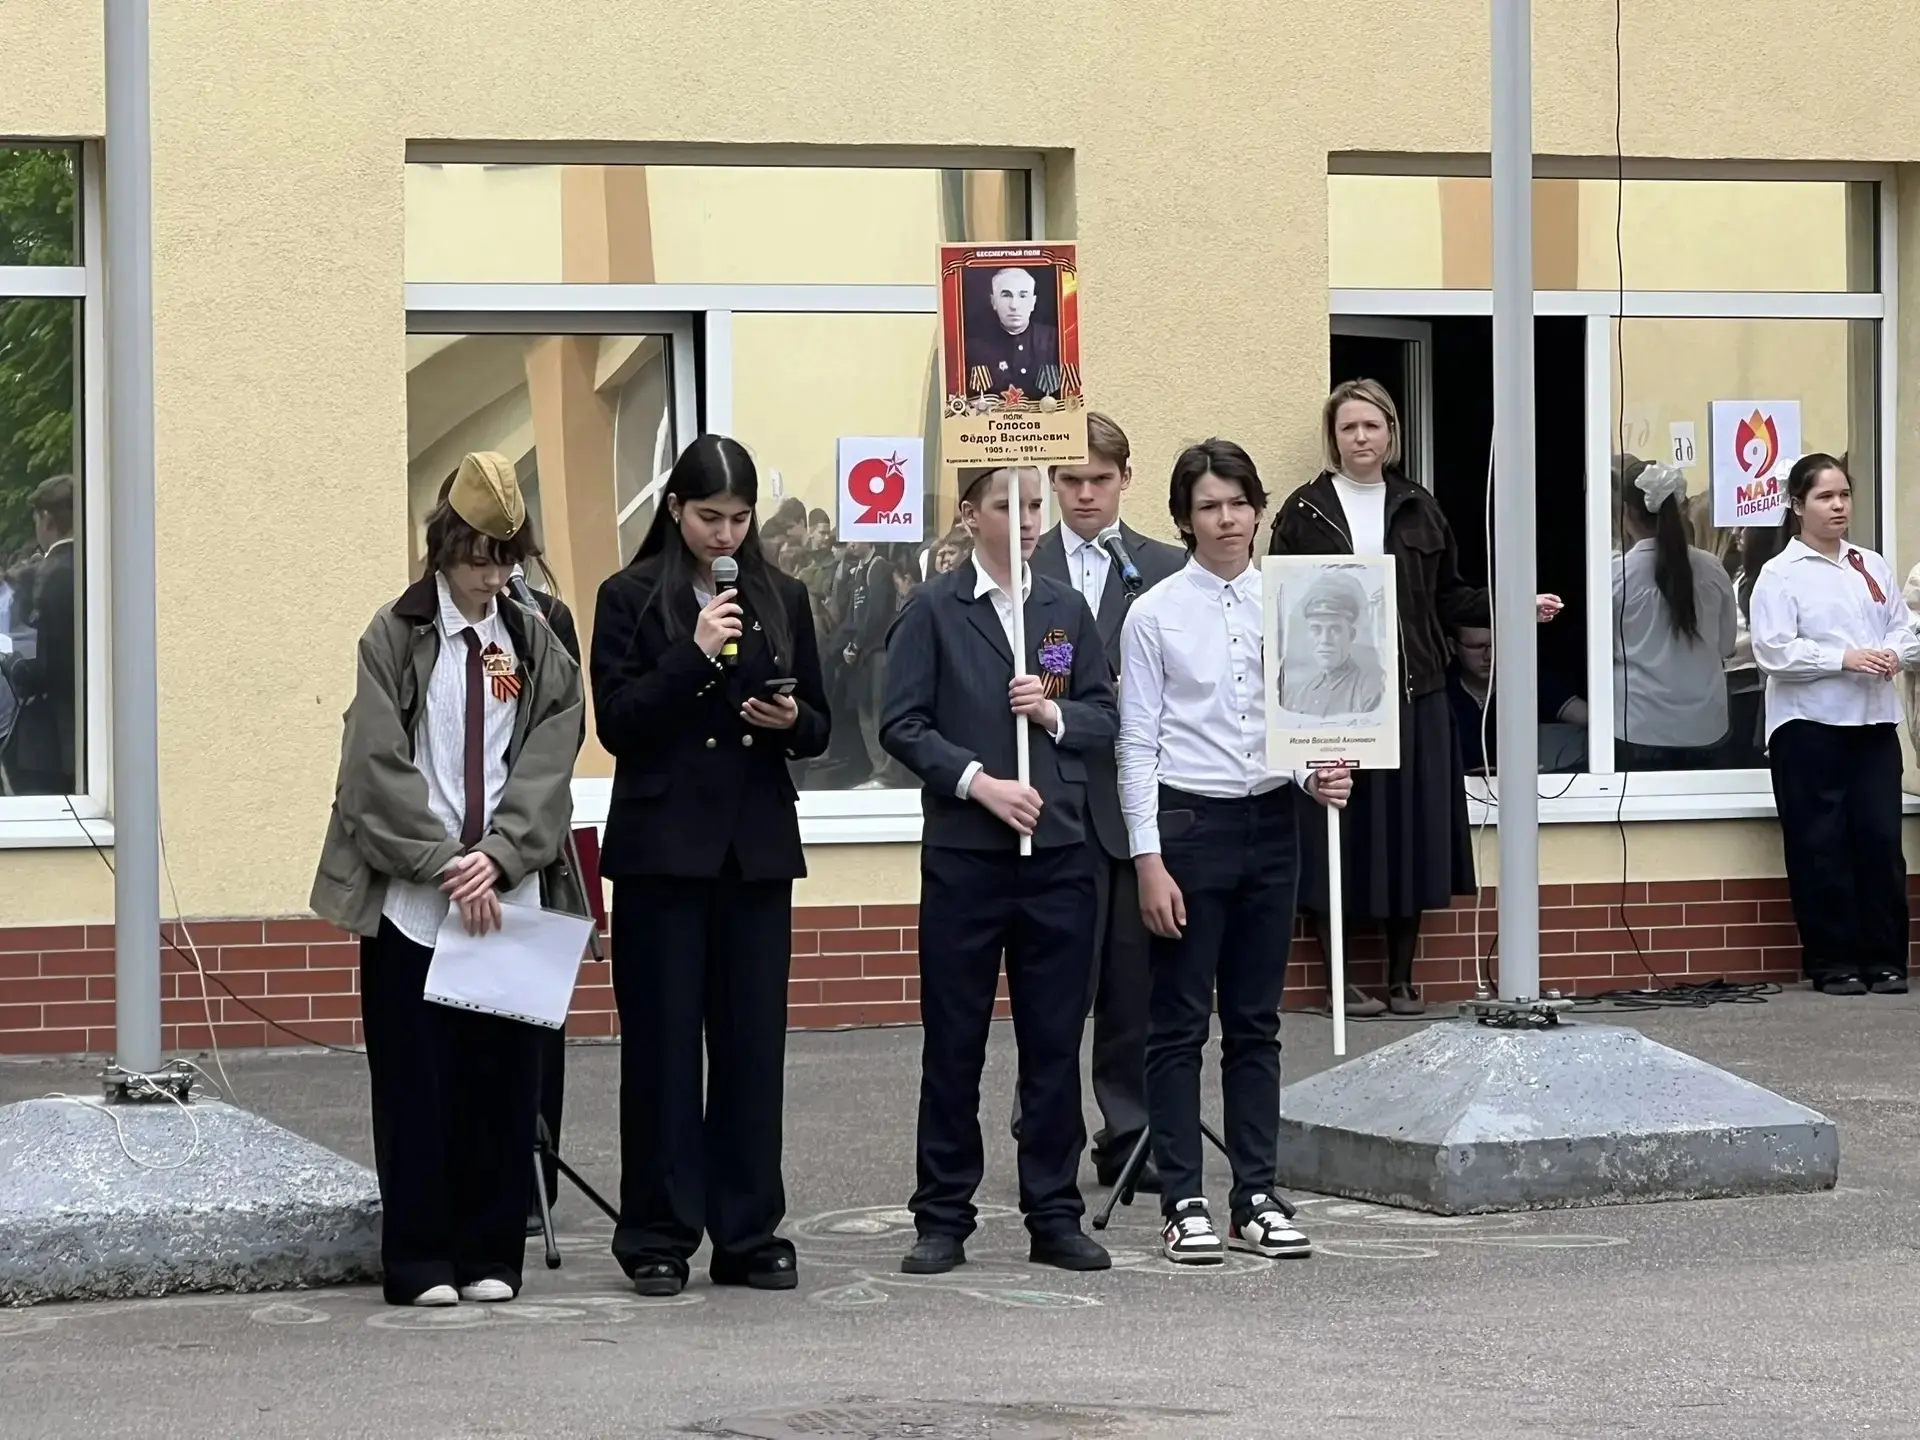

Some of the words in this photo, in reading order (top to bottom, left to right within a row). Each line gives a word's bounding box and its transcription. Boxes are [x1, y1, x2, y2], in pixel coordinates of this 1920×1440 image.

[988, 420, 1041, 431] Голосов
[960, 433, 997, 445] Фёдор
[1000, 433, 1070, 442] Васильевич
[847, 458, 905, 524] 9
[878, 512, 912, 525] МАЯ
[1736, 476, 1778, 505] МАЯ
[1736, 494, 1781, 518] ПОБЕДА!
